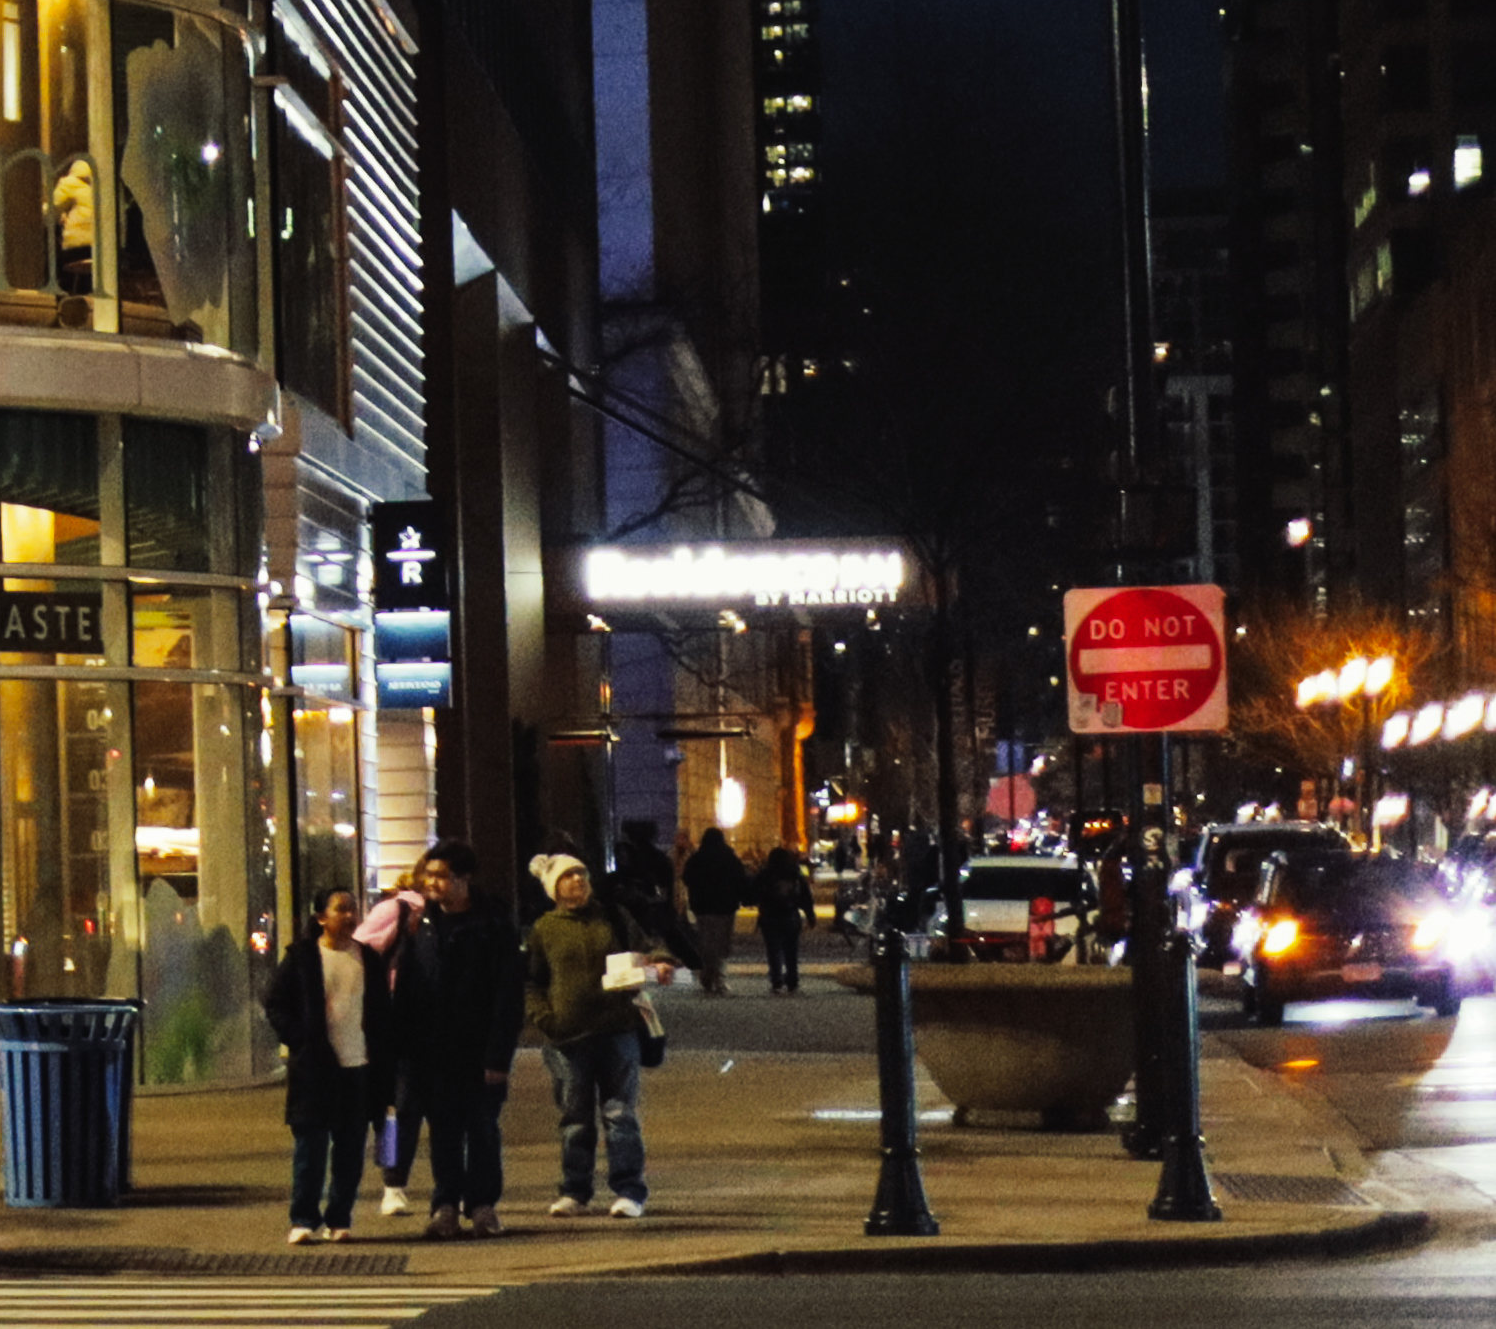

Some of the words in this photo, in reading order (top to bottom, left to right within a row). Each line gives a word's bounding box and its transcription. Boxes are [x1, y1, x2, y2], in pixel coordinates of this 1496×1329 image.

[755, 590, 783, 607] BY
[788, 587, 900, 606] MARRIOTT
[1089, 618, 1125, 641] DO
[1144, 614, 1196, 638] NOT
[1105, 678, 1190, 702] ENTER
